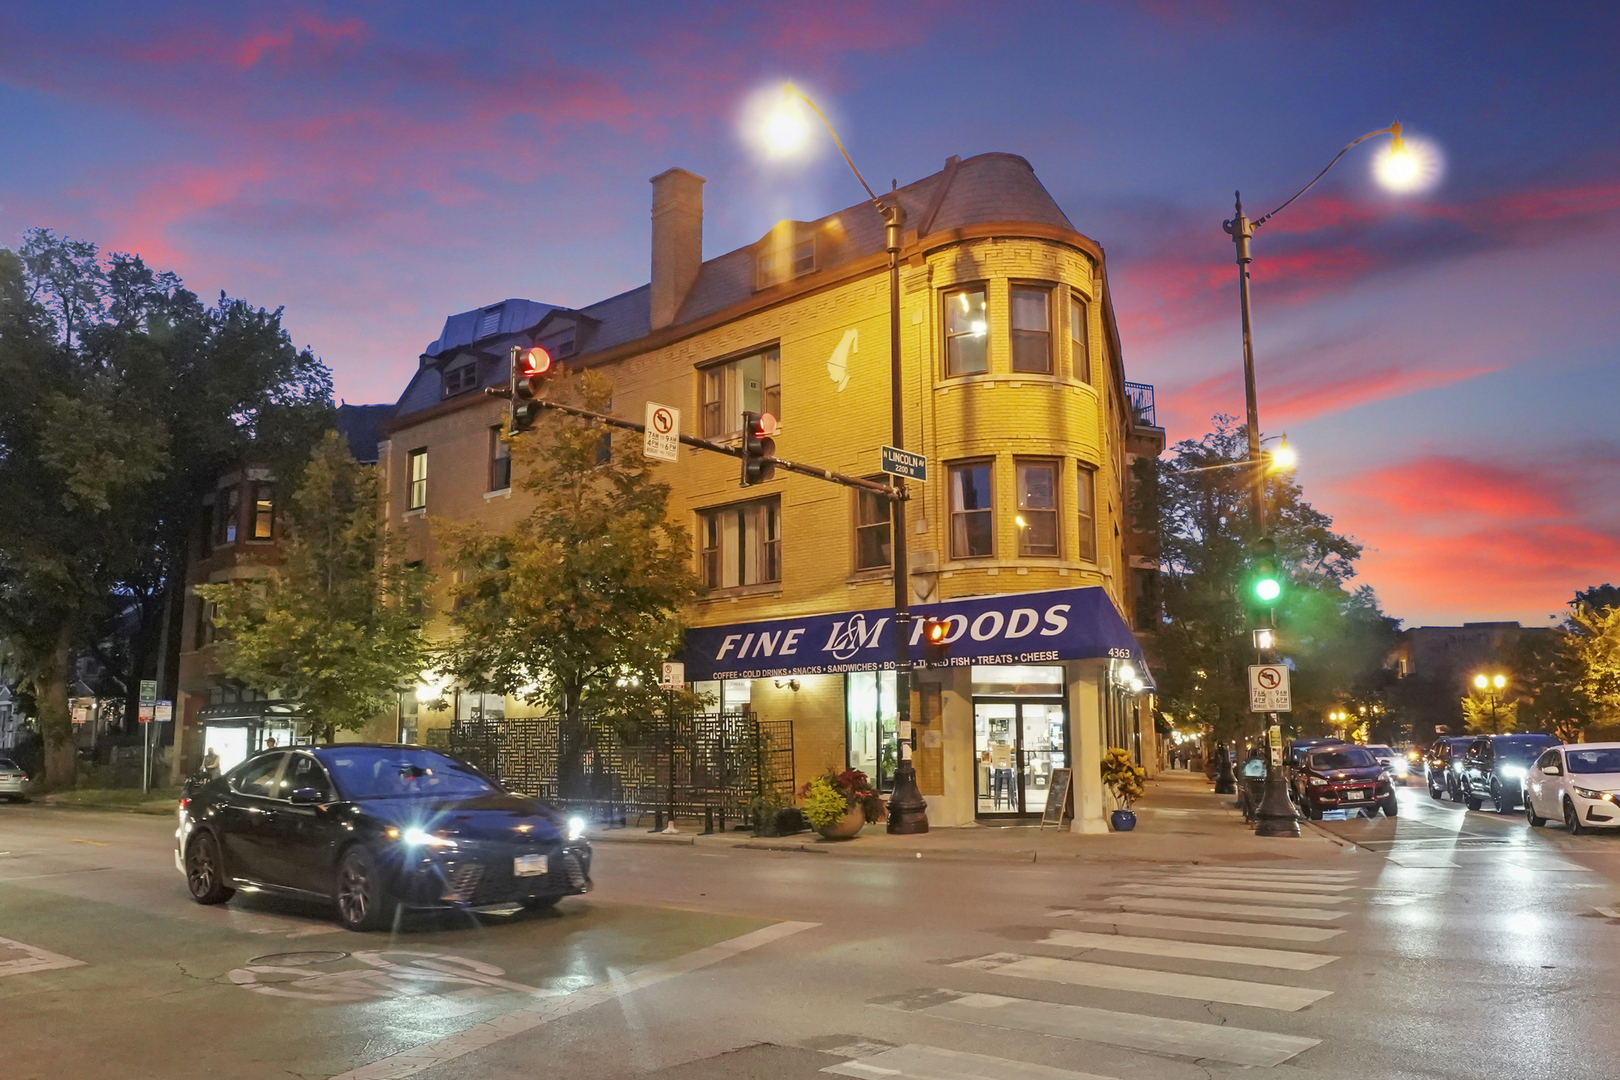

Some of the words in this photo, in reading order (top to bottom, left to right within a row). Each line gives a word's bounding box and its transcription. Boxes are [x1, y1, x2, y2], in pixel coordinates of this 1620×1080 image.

[888, 450, 918, 467] LINCOLN
[895, 464, 908, 474] 2200
[715, 628, 806, 660] FINE
[909, 604, 1072, 646] FOODS
[1108, 647, 1130, 659] 4363
[713, 671, 738, 680] COFFEE
[742, 669, 761, 678] COLD
[762, 667, 788, 677] DRINKS
[792, 665, 822, 675] SNACKS
[827, 662, 878, 673] SANDWICHES
[918, 659, 949, 668] TIED
[950, 658, 970, 666] FISH
[977, 654, 1013, 665] TREATS
[1020, 651, 1059, 662] CHEESE
